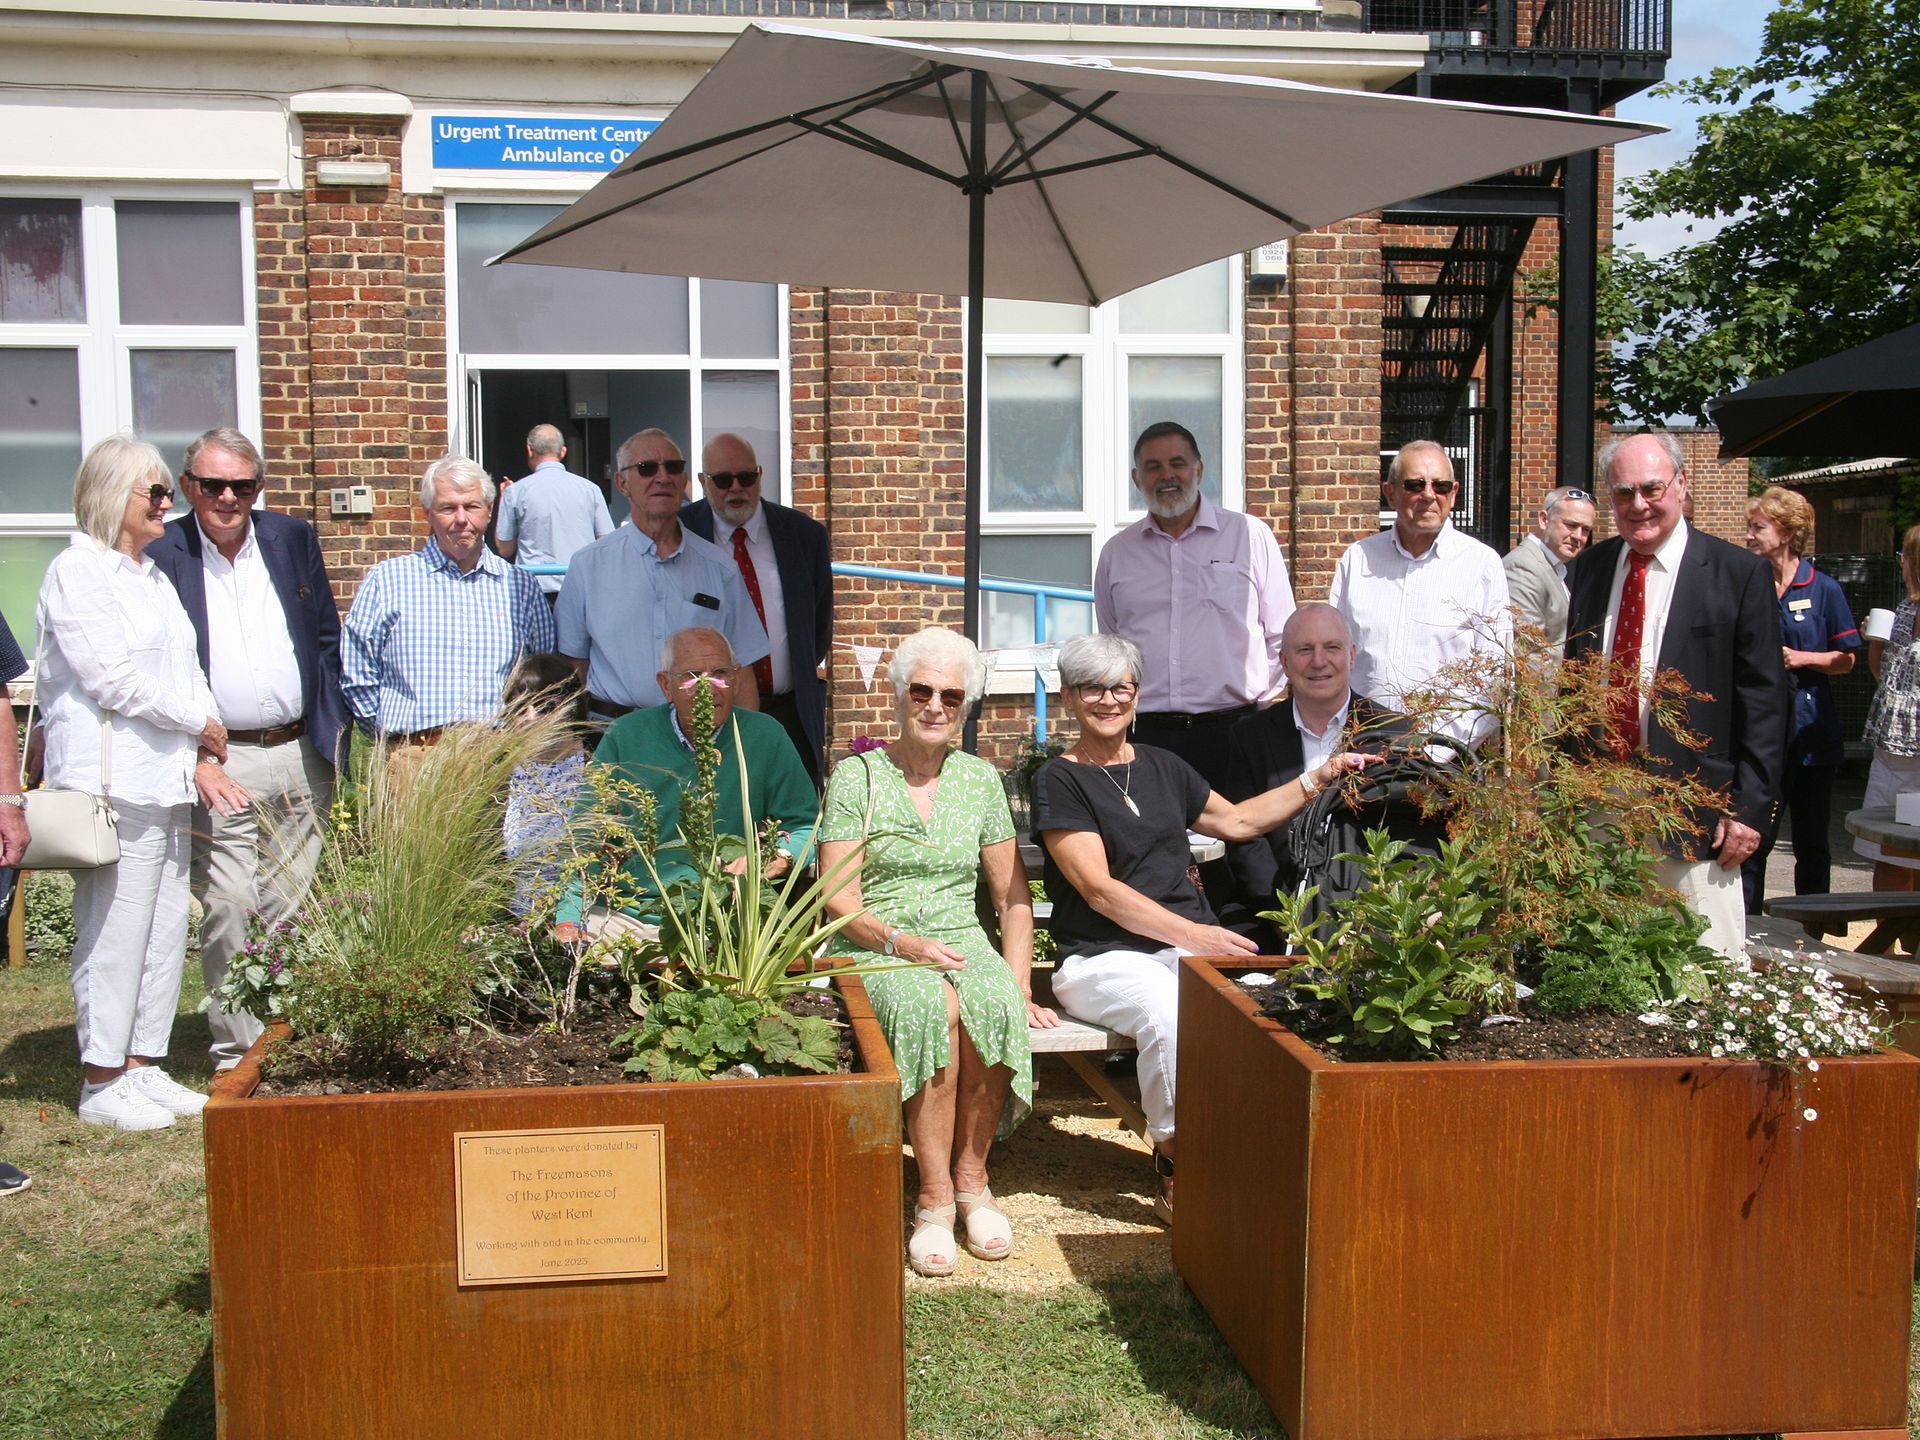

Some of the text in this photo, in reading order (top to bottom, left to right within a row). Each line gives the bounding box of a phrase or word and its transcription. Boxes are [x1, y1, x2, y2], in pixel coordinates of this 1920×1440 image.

[439, 123, 501, 142] Urgent
[505, 124, 597, 141] Treatment
[501, 147, 604, 163] Ambulance
[483, 1146, 512, 1155] These
[515, 1145, 555, 1155] planters
[583, 1142, 622, 1151] donated
[625, 1142, 638, 1152] by
[511, 1169, 612, 1181] The Freemasons
[506, 1187, 617, 1203] of the Province of
[532, 1209, 593, 1221] West Kent
[476, 1236, 649, 1250] Working with and in the community.
[540, 1258, 562, 1267] June
